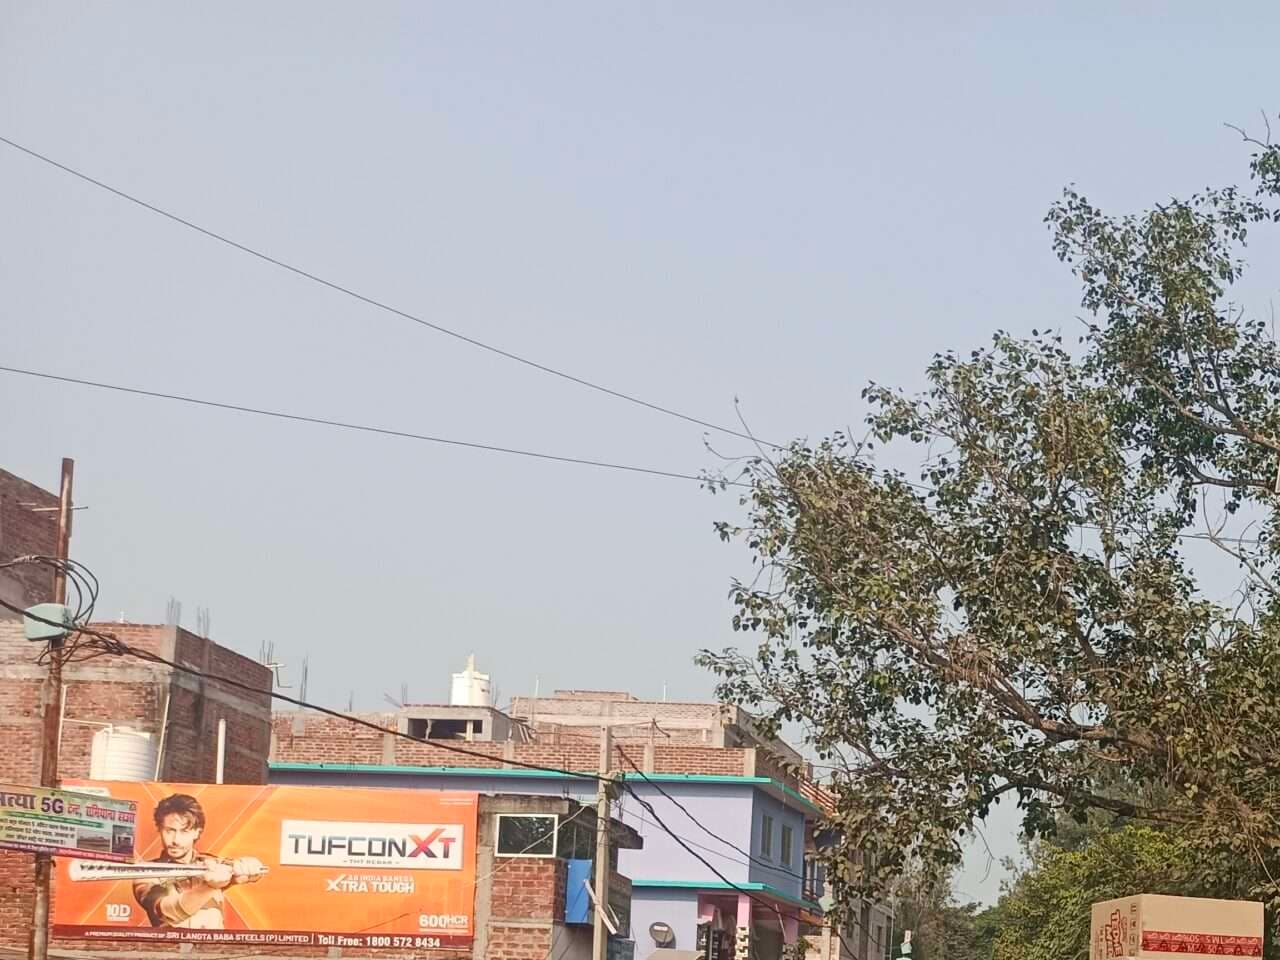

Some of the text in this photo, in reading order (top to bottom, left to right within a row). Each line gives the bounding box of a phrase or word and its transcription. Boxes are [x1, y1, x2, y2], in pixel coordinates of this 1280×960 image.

[41, 797, 64, 814] 5G
[371, 881, 415, 894] TOUGH
[106, 904, 131, 917] 10D
[166, 931, 180, 939] SRI
[213, 933, 234, 941] BABA
[235, 934, 265, 942] STEELS
[279, 935, 309, 943] LIMITED
[318, 935, 441, 948] Toll Free: 1800 572 8434
